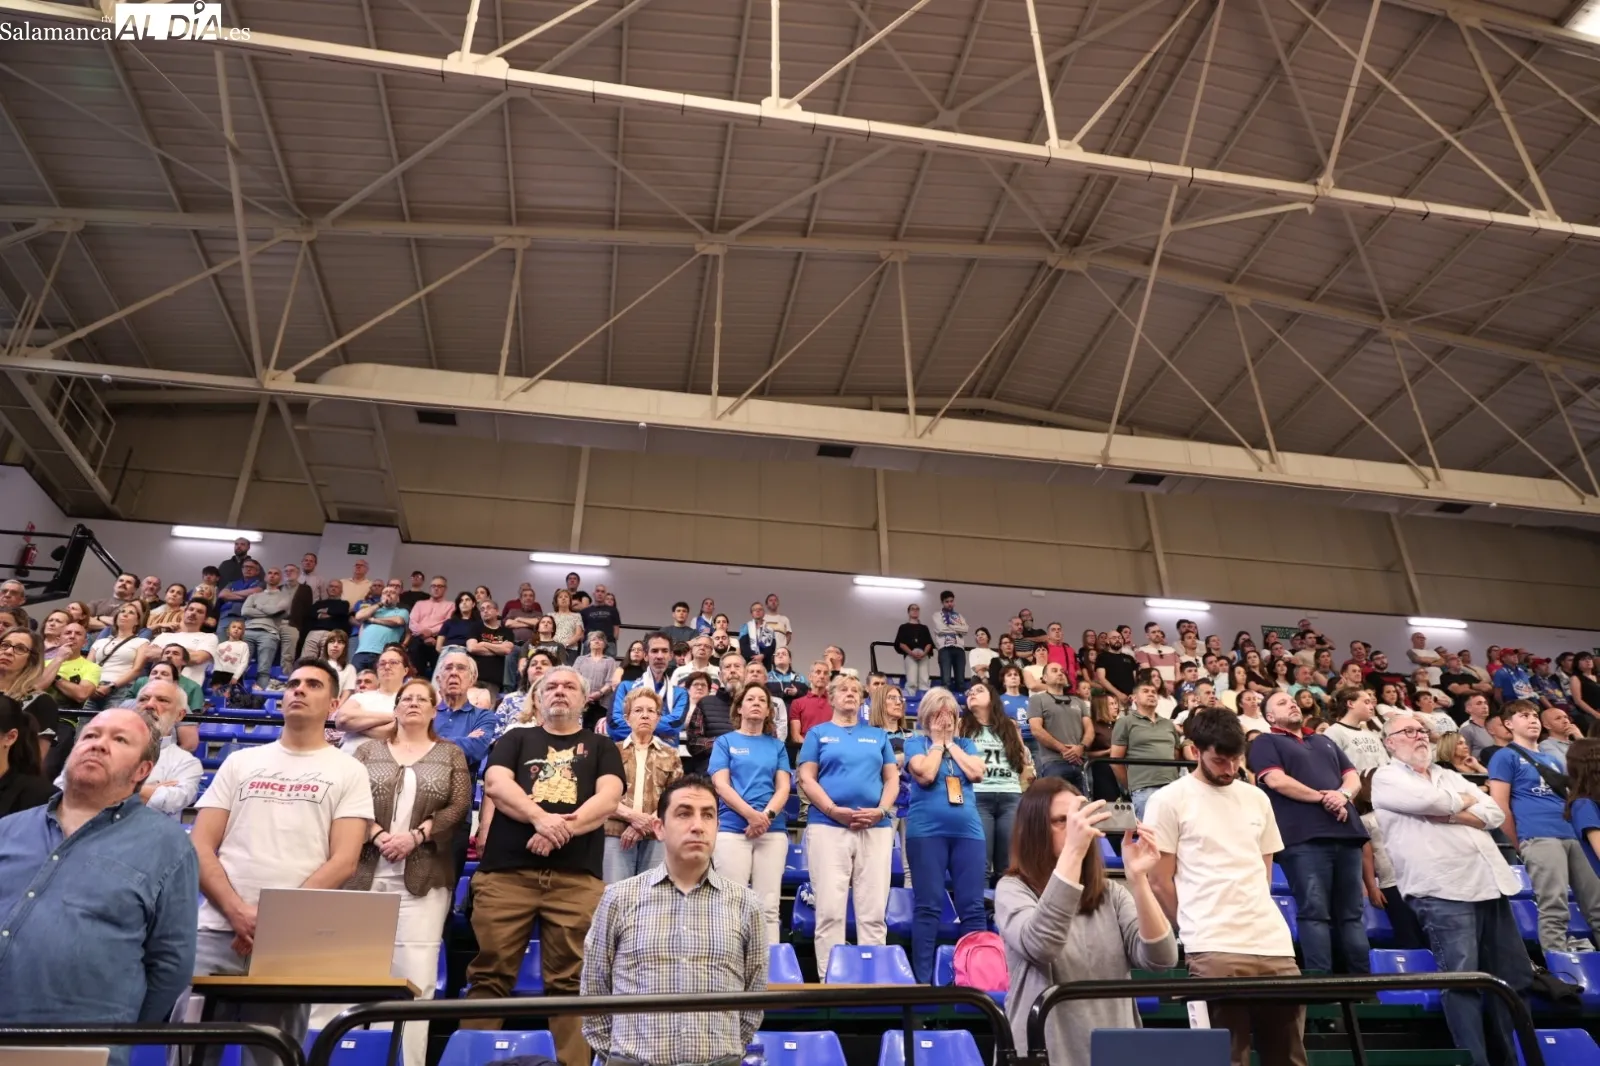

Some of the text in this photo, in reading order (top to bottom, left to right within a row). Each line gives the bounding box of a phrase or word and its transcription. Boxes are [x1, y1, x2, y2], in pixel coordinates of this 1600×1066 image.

[984, 749, 1000, 764] 21
[248, 781, 319, 793] SINCE 1990
